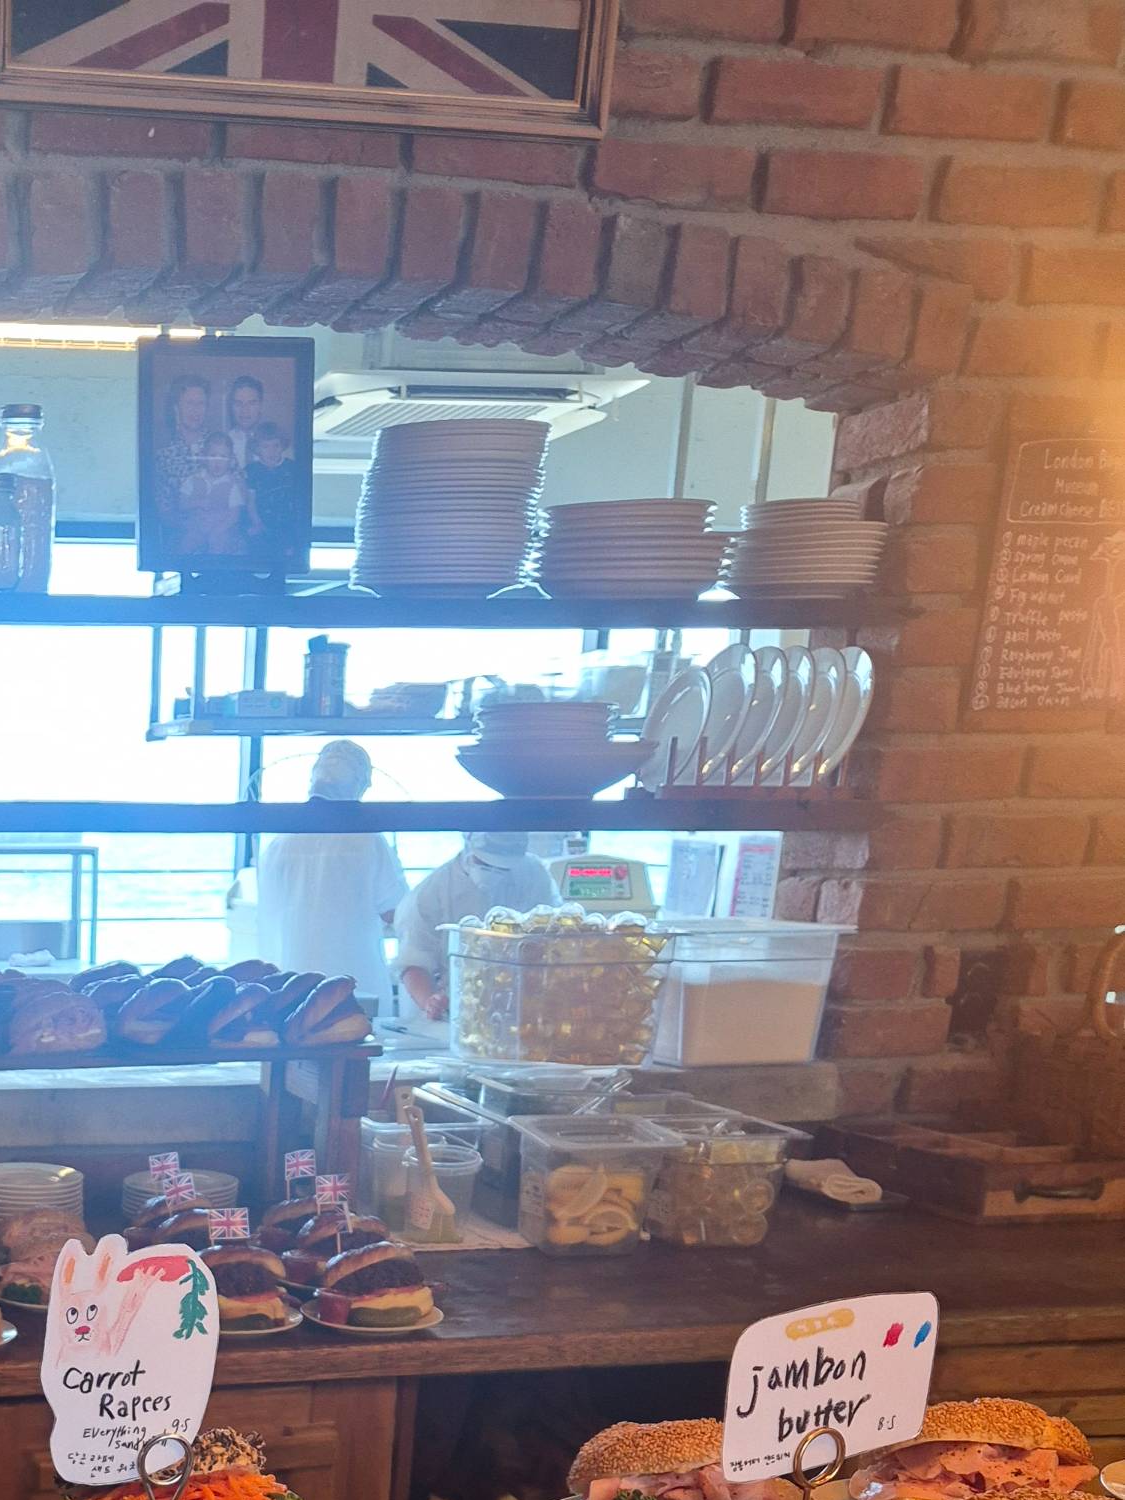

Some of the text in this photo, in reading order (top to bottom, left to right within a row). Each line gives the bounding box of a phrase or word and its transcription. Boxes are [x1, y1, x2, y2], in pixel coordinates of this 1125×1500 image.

[63, 1360, 146, 1393] Carrot
[736, 1346, 867, 1419] jambon
[777, 1393, 871, 1443] butter
